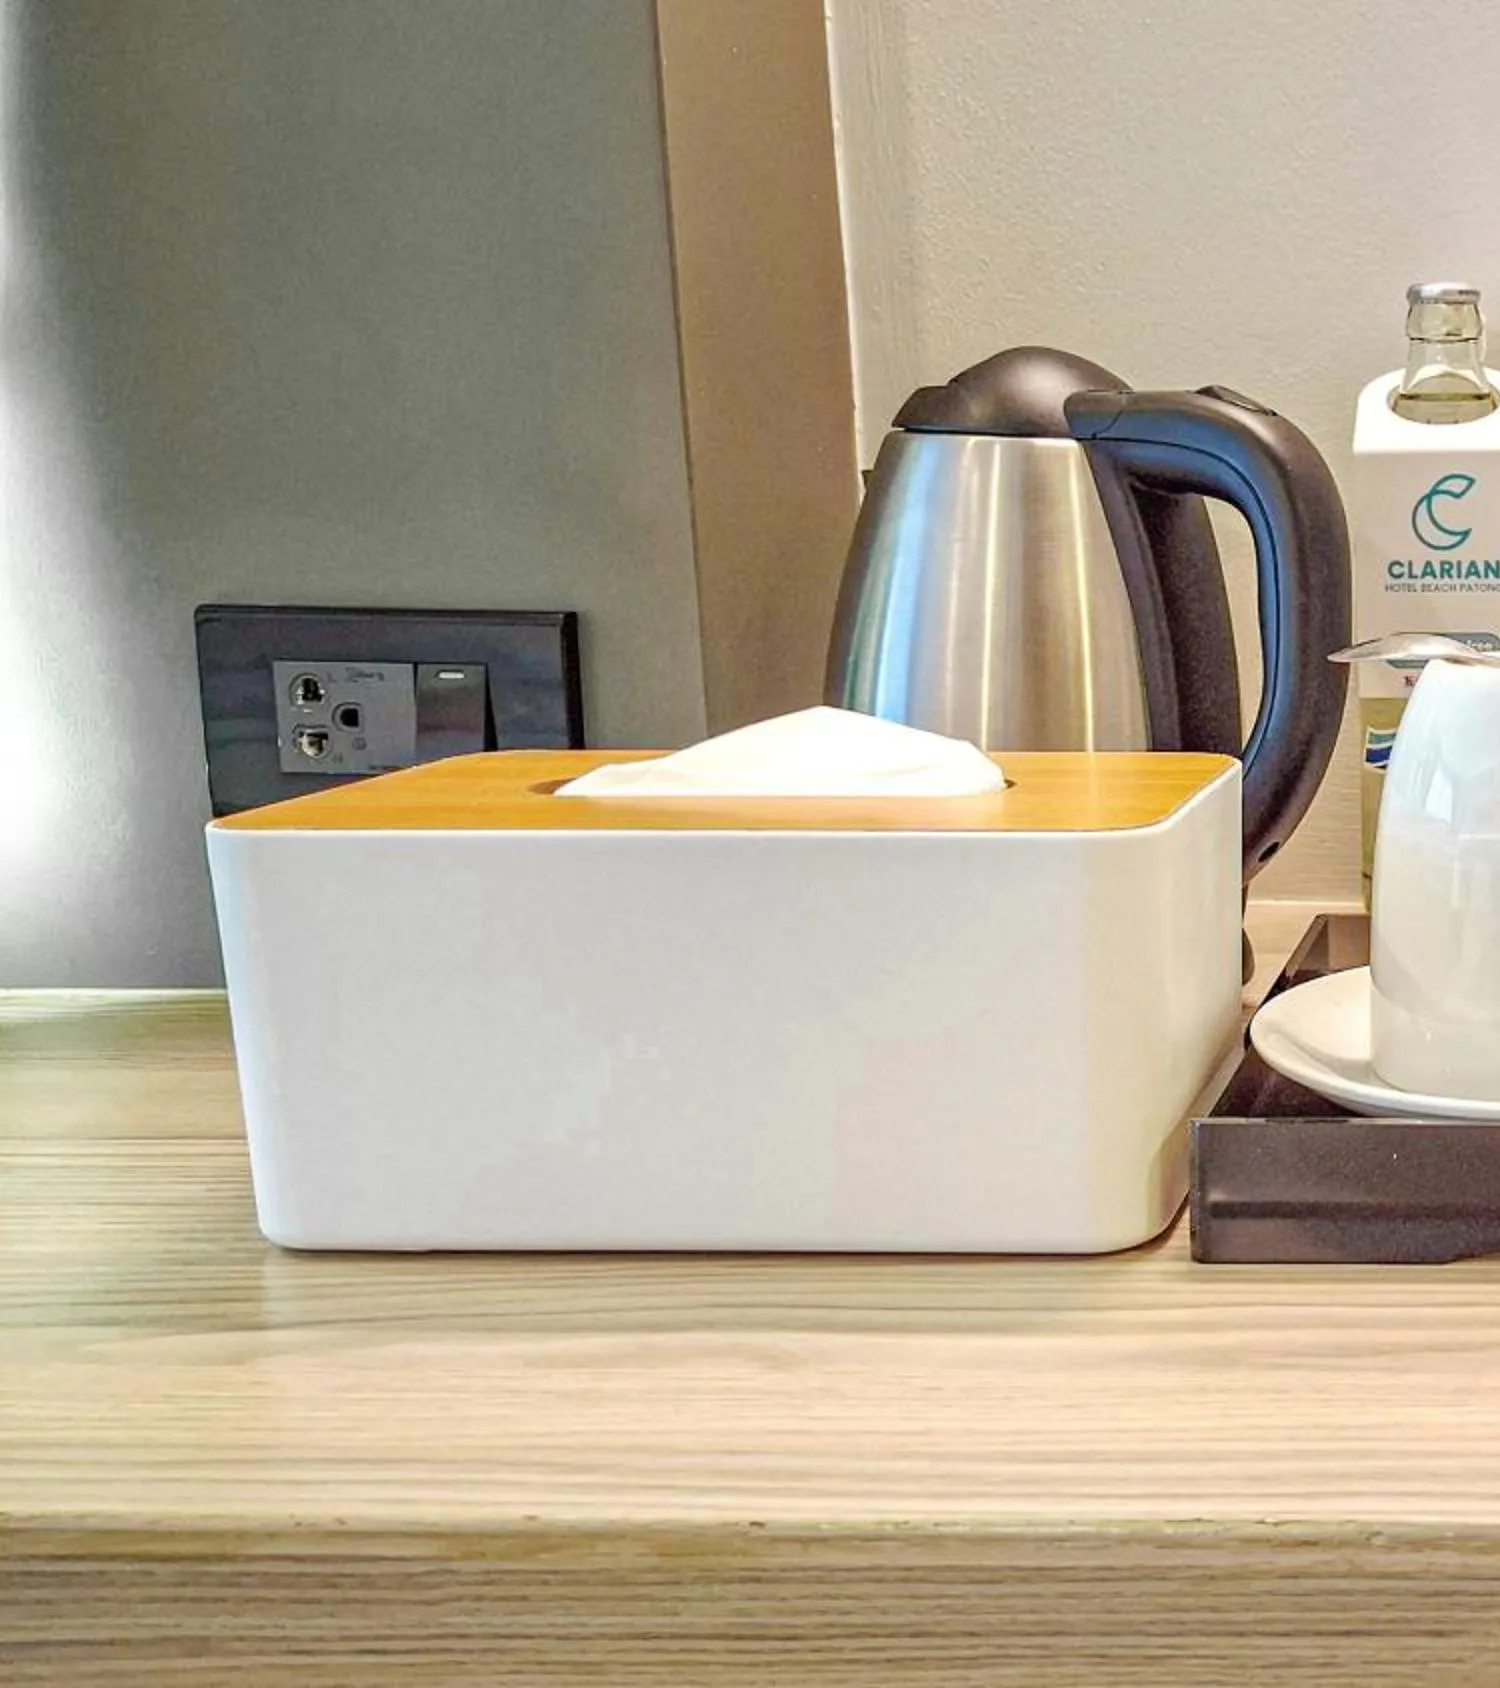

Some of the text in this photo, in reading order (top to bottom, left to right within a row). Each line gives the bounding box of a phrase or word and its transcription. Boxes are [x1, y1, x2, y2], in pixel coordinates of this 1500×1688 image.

[1387, 559, 1500, 579] CLARIAN
[1385, 583, 1417, 593] HOTEL
[1421, 583, 1457, 593] BEACH
